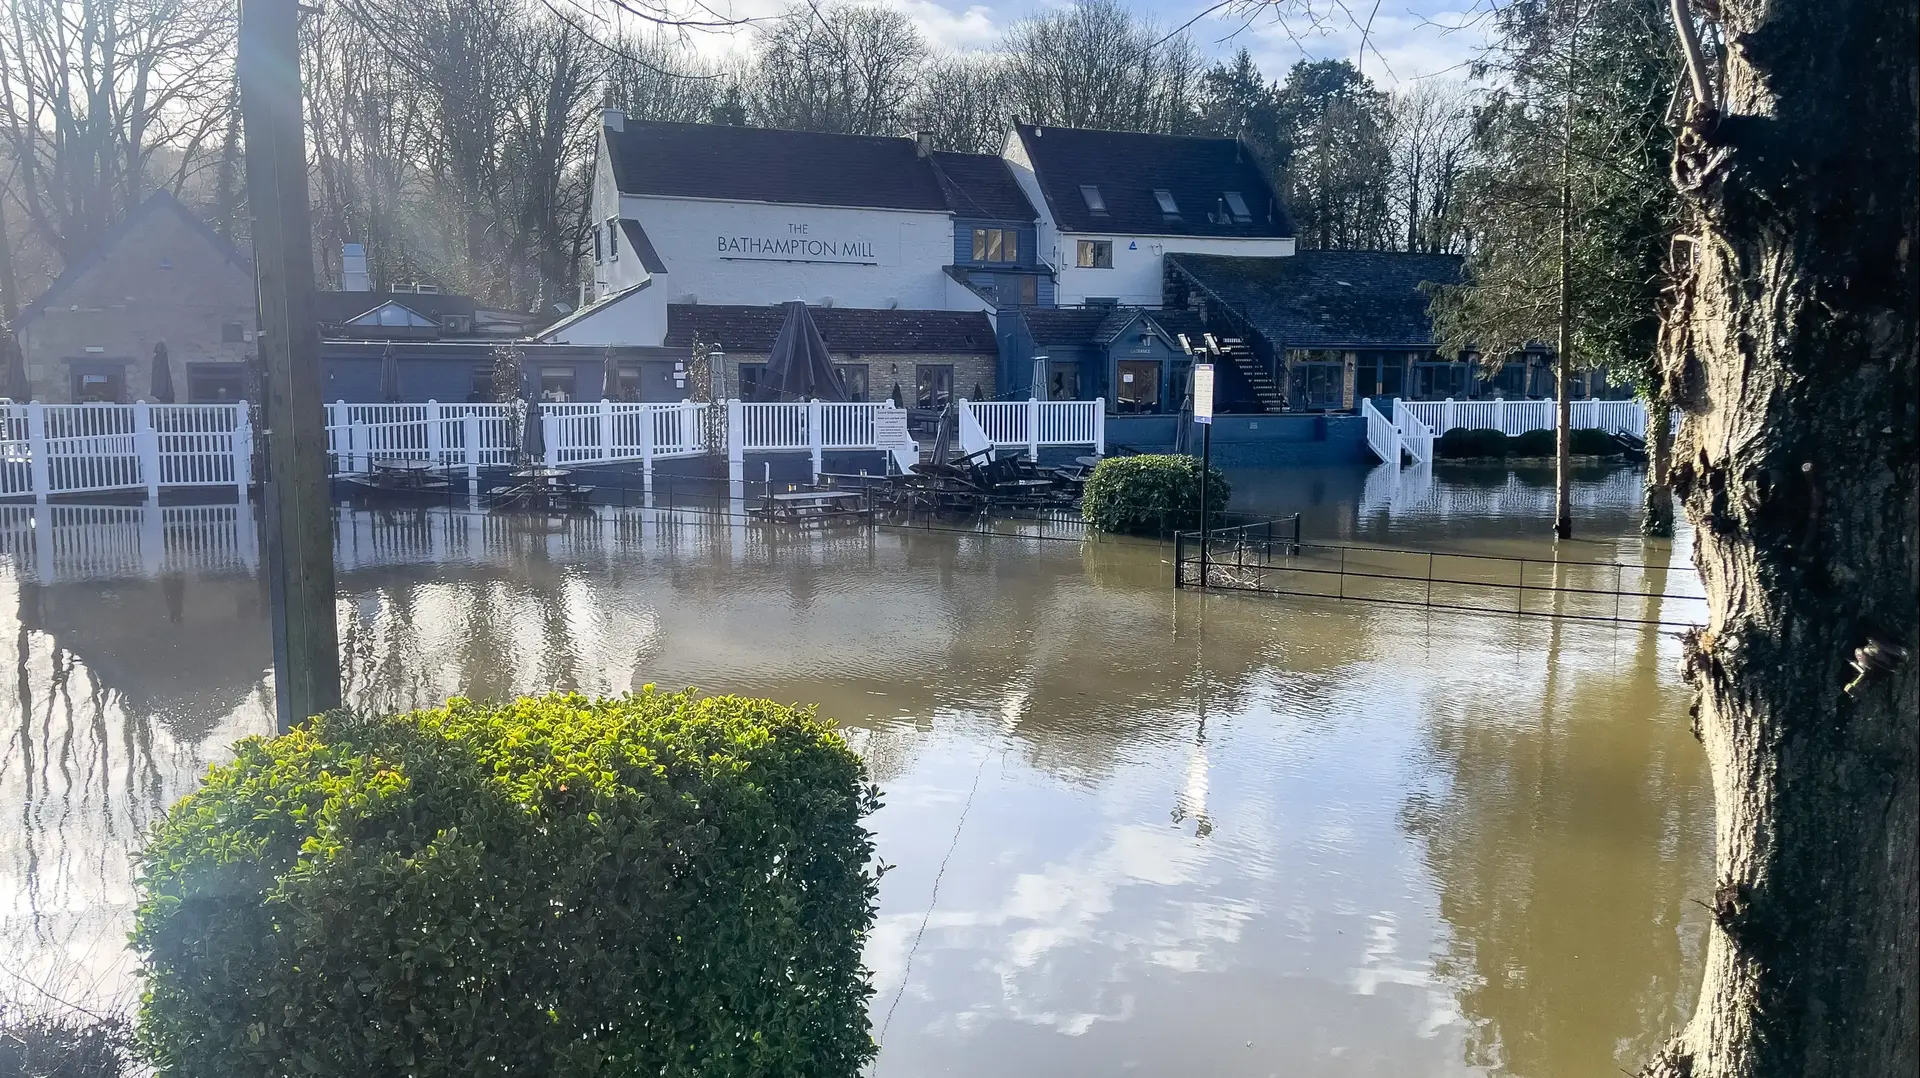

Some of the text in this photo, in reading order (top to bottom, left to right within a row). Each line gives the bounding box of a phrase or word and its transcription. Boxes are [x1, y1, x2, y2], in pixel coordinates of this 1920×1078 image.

[788, 223, 808, 234] THE
[718, 236, 874, 257] BATHAMPTON MILL
